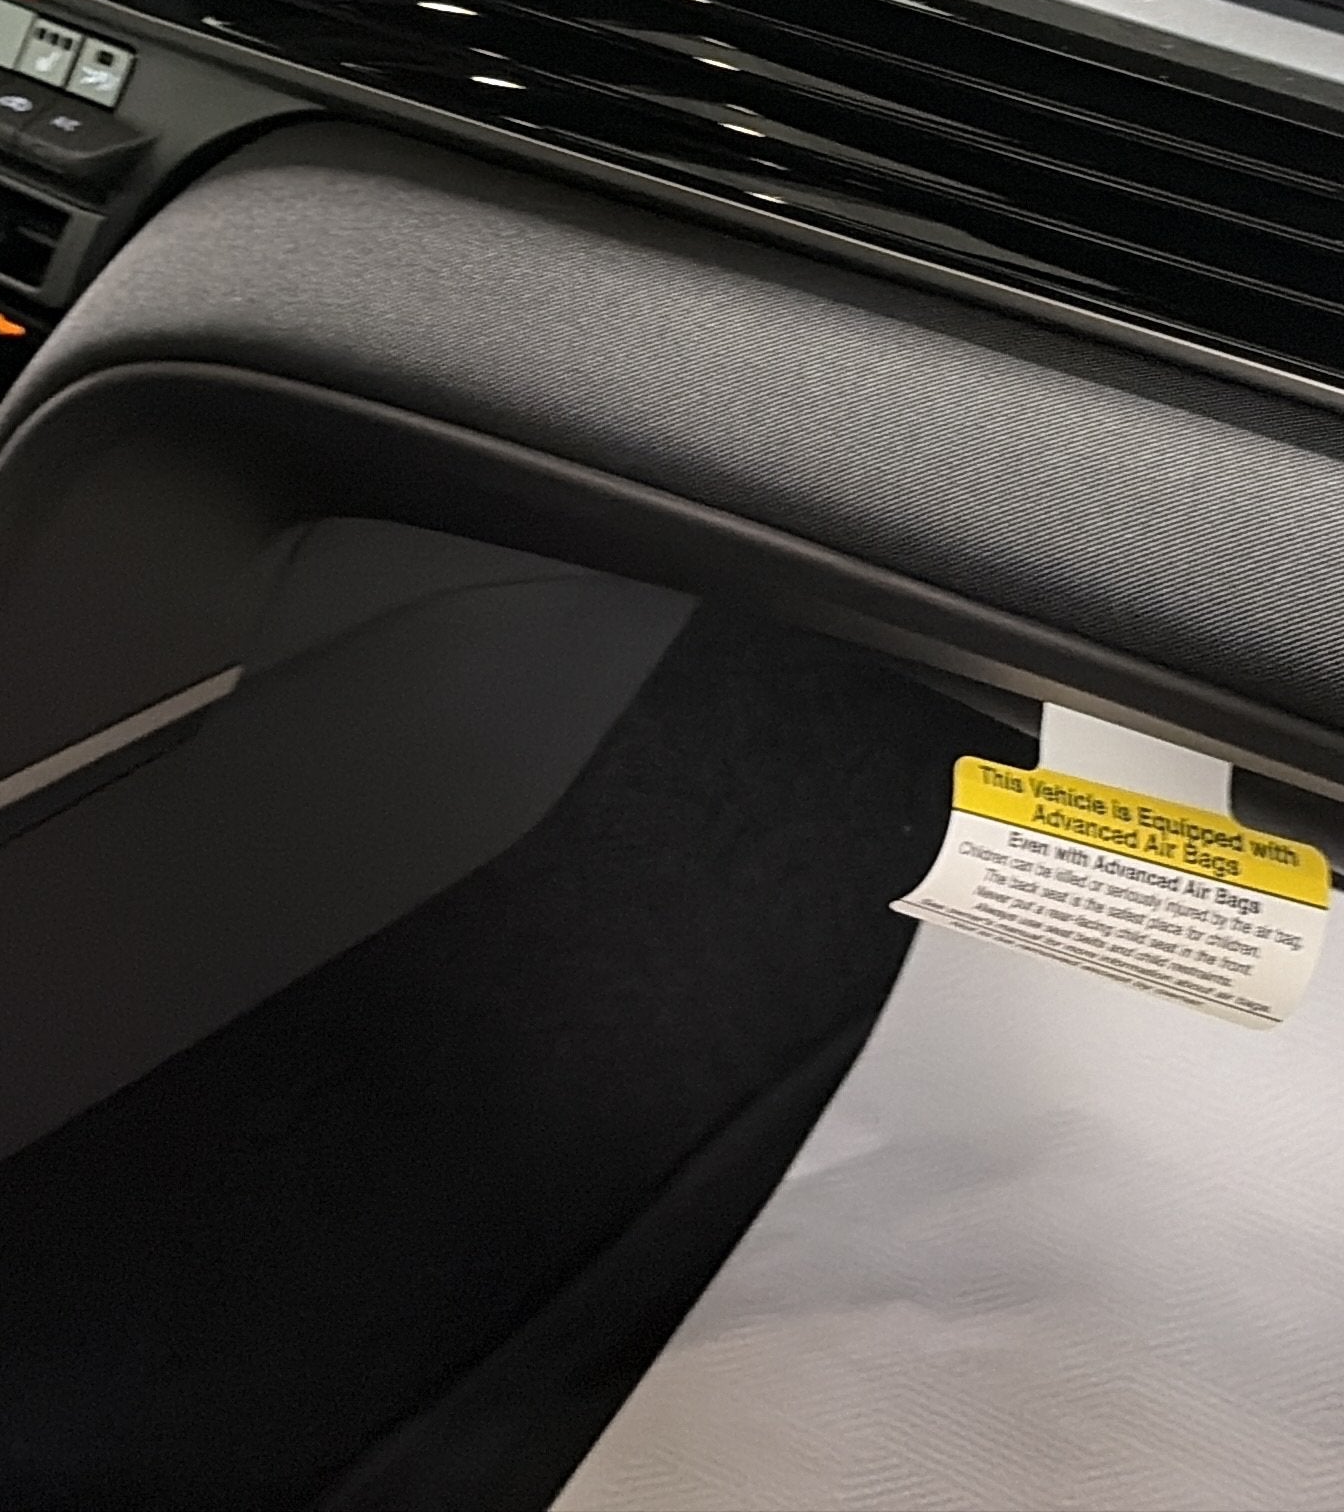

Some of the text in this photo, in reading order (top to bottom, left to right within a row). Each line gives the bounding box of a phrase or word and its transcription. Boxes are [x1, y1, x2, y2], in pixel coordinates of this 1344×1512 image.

[977, 764, 1299, 867] This Vehicle is Equipped with
[1031, 803, 1240, 878] Advanced Air Bags
[1007, 830, 1261, 915] Even with Advanced Air Bags
